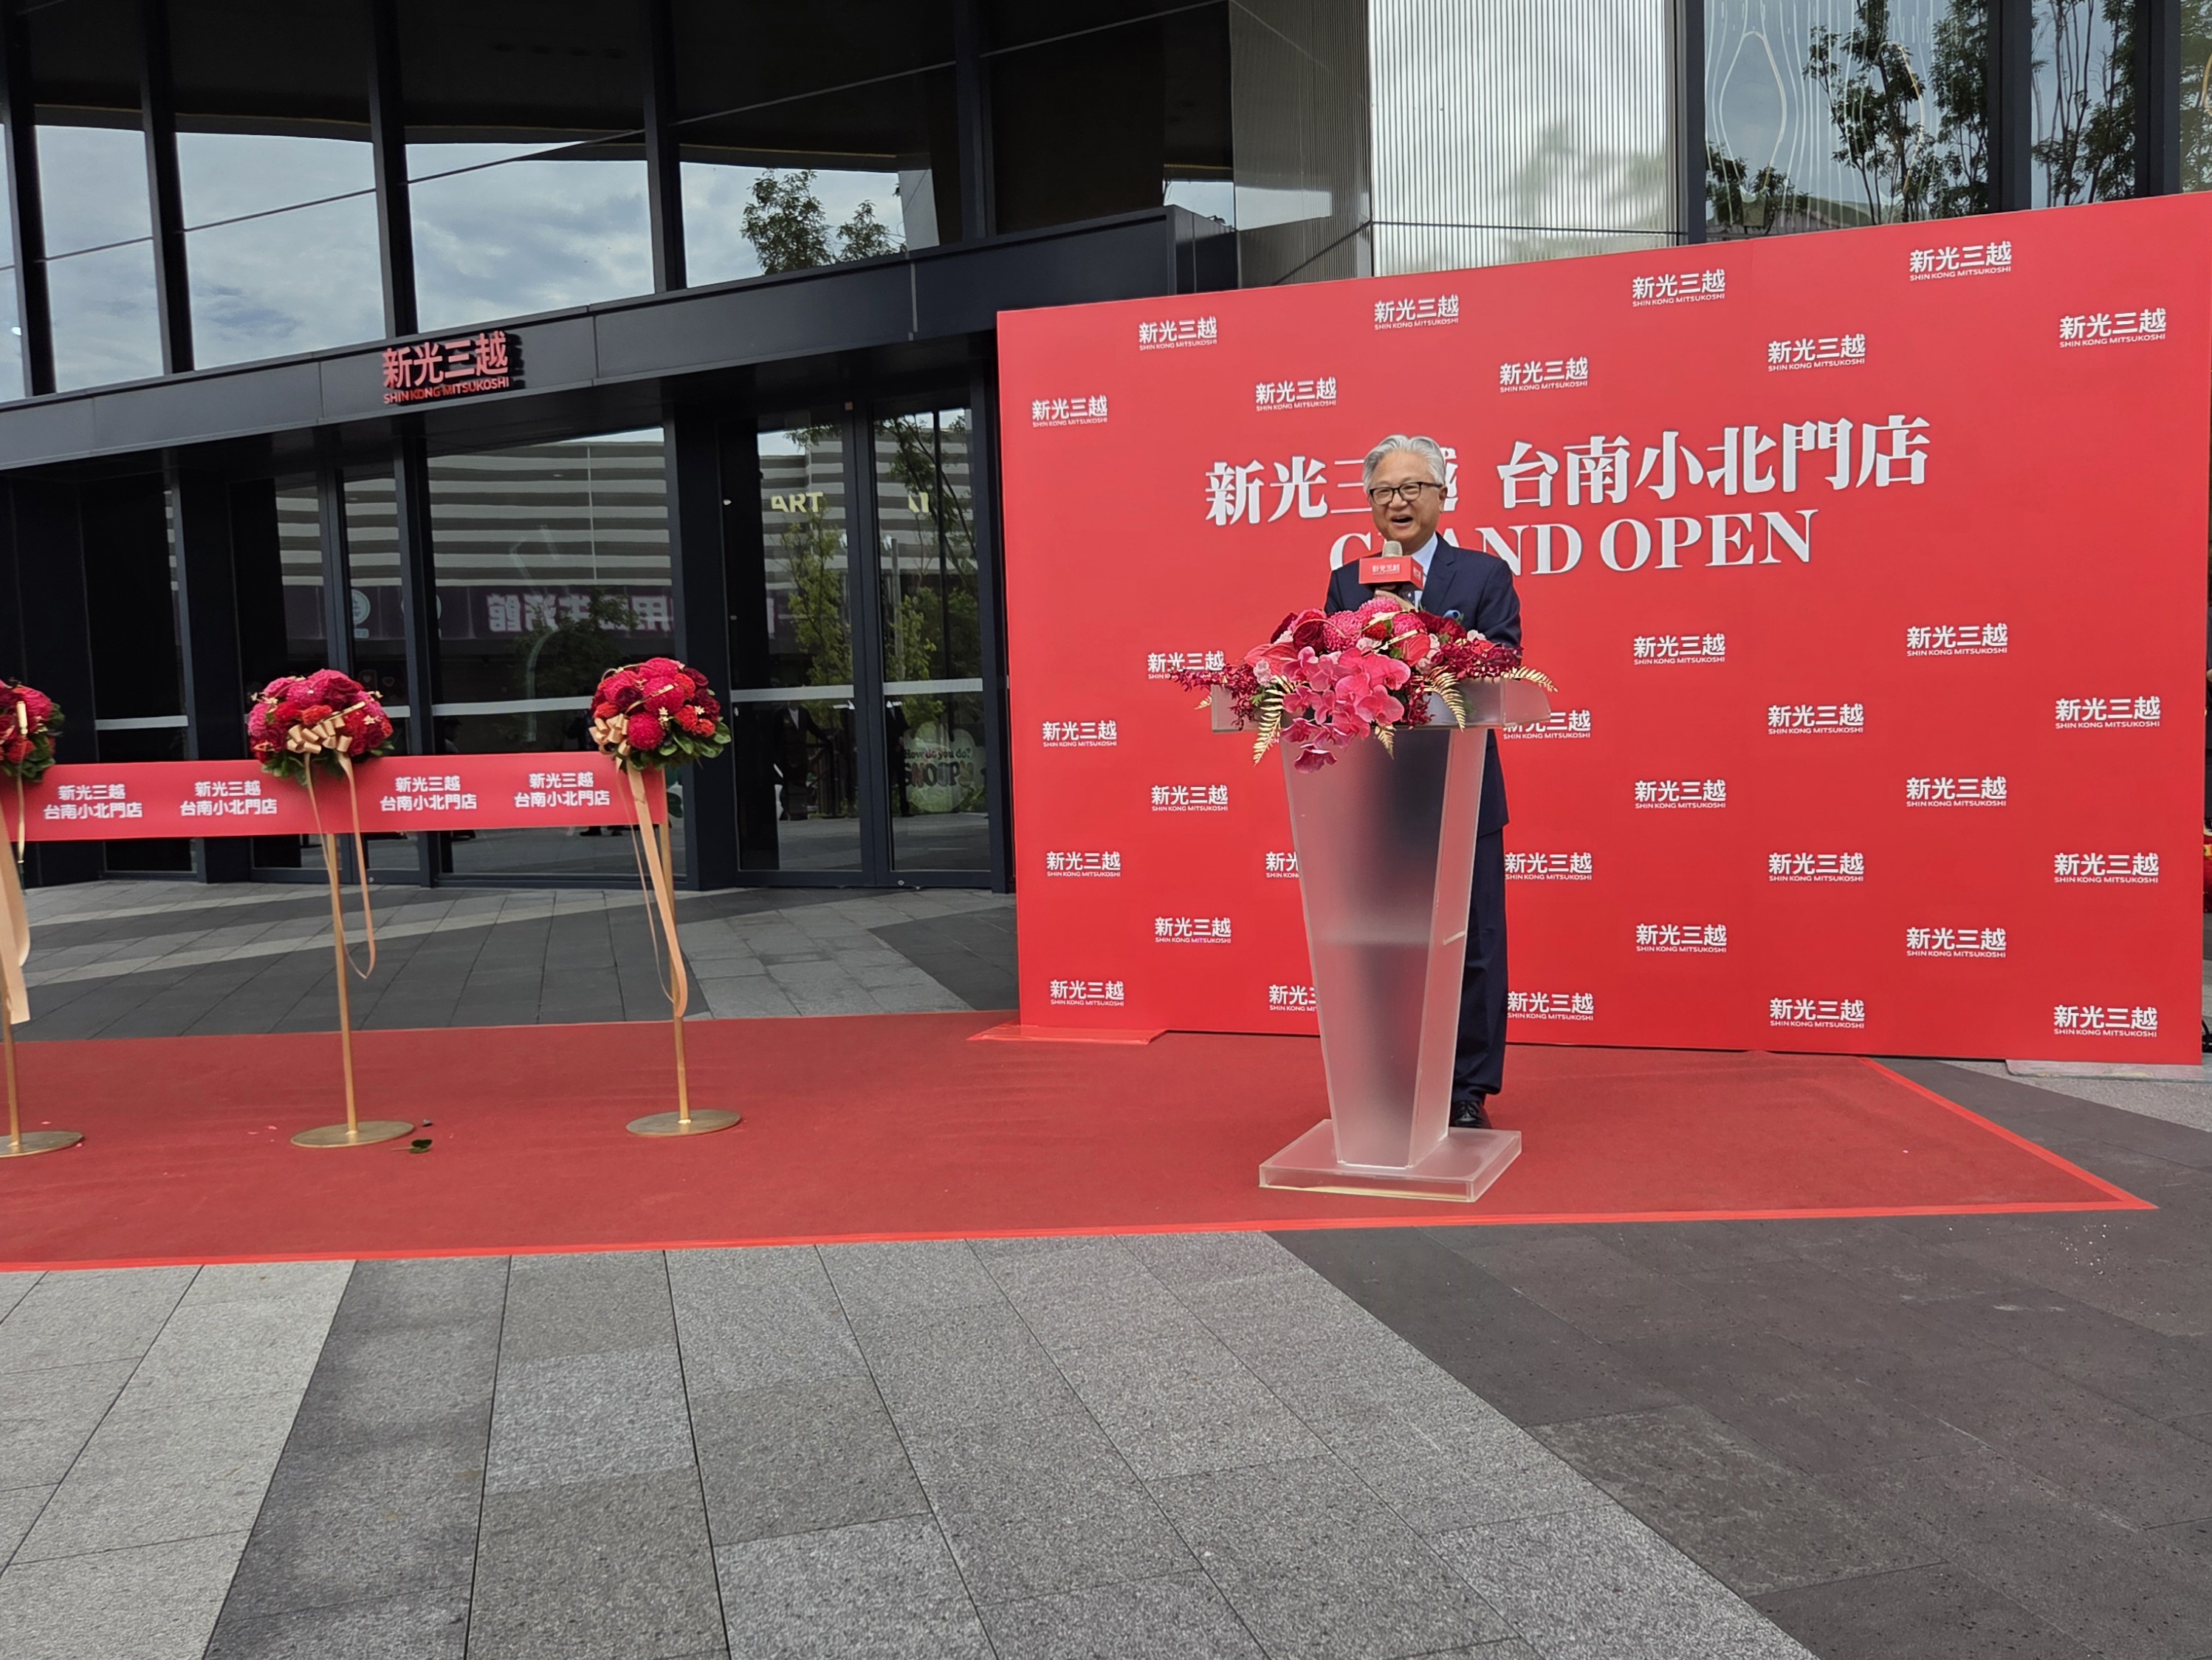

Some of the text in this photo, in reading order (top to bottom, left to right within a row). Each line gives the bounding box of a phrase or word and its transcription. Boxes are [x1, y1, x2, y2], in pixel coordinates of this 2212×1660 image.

[1909, 241, 2012, 273] 新光三越
[1632, 268, 1725, 300] 新光三越
[1909, 266, 2011, 281] SHIN KONG MITSUKOSHI
[1374, 294, 1460, 323] 新光三越
[1675, 293, 1725, 303] MITSUKOSHI
[1138, 316, 1217, 344] 新光三越
[1414, 318, 1459, 326] MITSUKOSHI
[2059, 307, 2167, 340] 新光三越
[1175, 339, 1217, 348] MITSUKOSHI
[1768, 333, 1866, 364] 新光三越
[2109, 333, 2165, 343] MITSUKOSHI
[382, 330, 509, 388] 新光三越
[1788, 362, 1813, 370] KONG
[1813, 358, 1865, 368] MITSUKOSHI
[1500, 357, 1588, 385] 新光三越
[383, 377, 509, 405] SHIN KONG MITSUKOSHI
[1255, 377, 1337, 405] 新光三越
[1541, 380, 1588, 389] MITSUKOSHI
[1031, 394, 1108, 421] 新光三越
[1294, 399, 1336, 408] MITSUKOSHI
[1205, 414, 1931, 527] 新光三 台南小北門店
[1599, 509, 1818, 572] OPEN
[1633, 633, 1726, 658] 新光三越
[1906, 622, 2008, 649] 新光三越
[1147, 650, 1225, 673] 新光三越
[1954, 647, 2007, 655] MITSUKOSHI
[1768, 703, 1864, 727] 新光三越
[2055, 696, 2161, 721] 新光三越
[1042, 720, 1117, 741] 新光三越
[1503, 709, 1591, 733] 三越
[58, 783, 126, 800] 新光三越
[194, 780, 261, 797] 新光三越
[394, 775, 461, 792] 新光三越
[529, 772, 594, 789] 新光三越
[1635, 779, 1727, 803] 新光三越
[1906, 775, 2007, 800] 新光三越
[379, 793, 477, 812] 台南小北門店
[514, 789, 610, 808] 台南小北門店
[1151, 784, 1229, 806] 新光三越
[43, 802, 142, 820] 台南小北門店
[179, 798, 278, 816] 台南小北門店
[1046, 851, 1121, 871] 新光三越
[1504, 851, 1593, 874] 新光三越
[1768, 852, 1864, 875] 新光三越
[2054, 852, 2160, 877] 新光三越
[1155, 916, 1232, 938] 新光三越
[1635, 923, 1727, 947] 新光三越
[1906, 927, 2007, 951] 新光三越
[1050, 979, 1124, 1001] 新光三越
[1507, 990, 1594, 1015] 新光三越
[1770, 997, 1865, 1022] 新光三越
[2053, 1004, 2158, 1030] 新光三越
[2103, 1029, 2157, 1038] MITSUKOSHI
